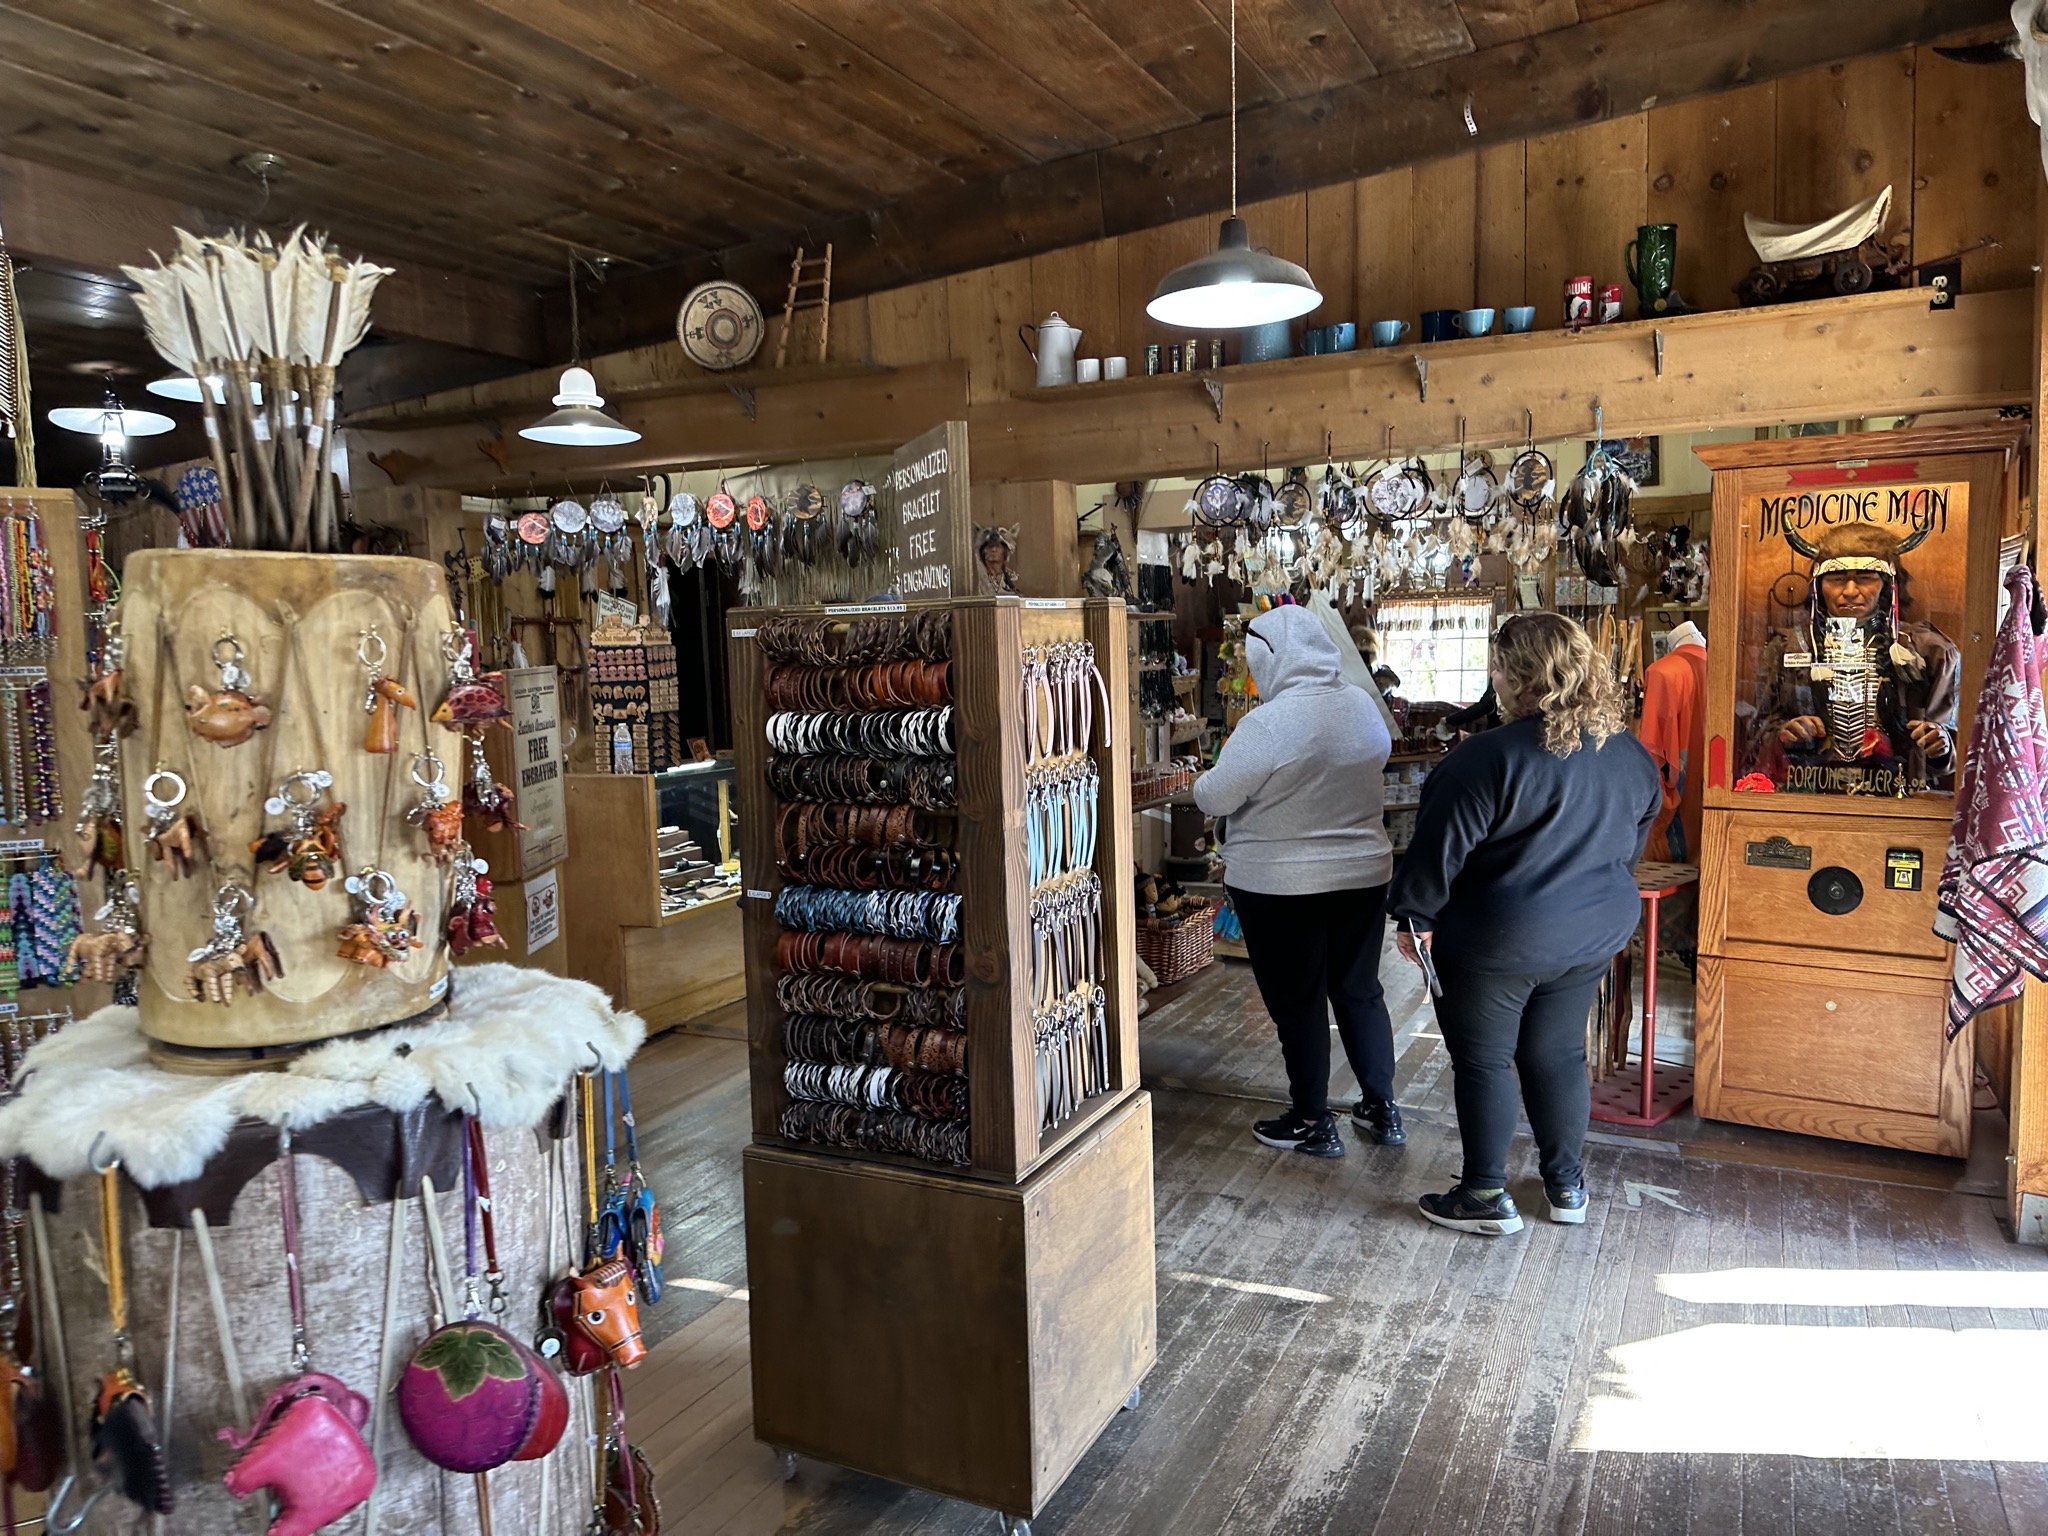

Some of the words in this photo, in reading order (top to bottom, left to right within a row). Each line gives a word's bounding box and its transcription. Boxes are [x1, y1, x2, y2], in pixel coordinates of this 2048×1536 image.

[1565, 282, 1592, 296] CALUME
[896, 448, 948, 491] PERSONALIZED
[902, 489, 940, 525] BRACELET
[1759, 491, 1878, 542] MEDICINE
[1886, 486, 1951, 534] MAN
[909, 529, 936, 560] FREE
[903, 564, 949, 593] ENGRAVING
[528, 736, 549, 763] FREE
[522, 760, 558, 788] ENGRAVING
[1787, 765, 1845, 791] FORTUNE
